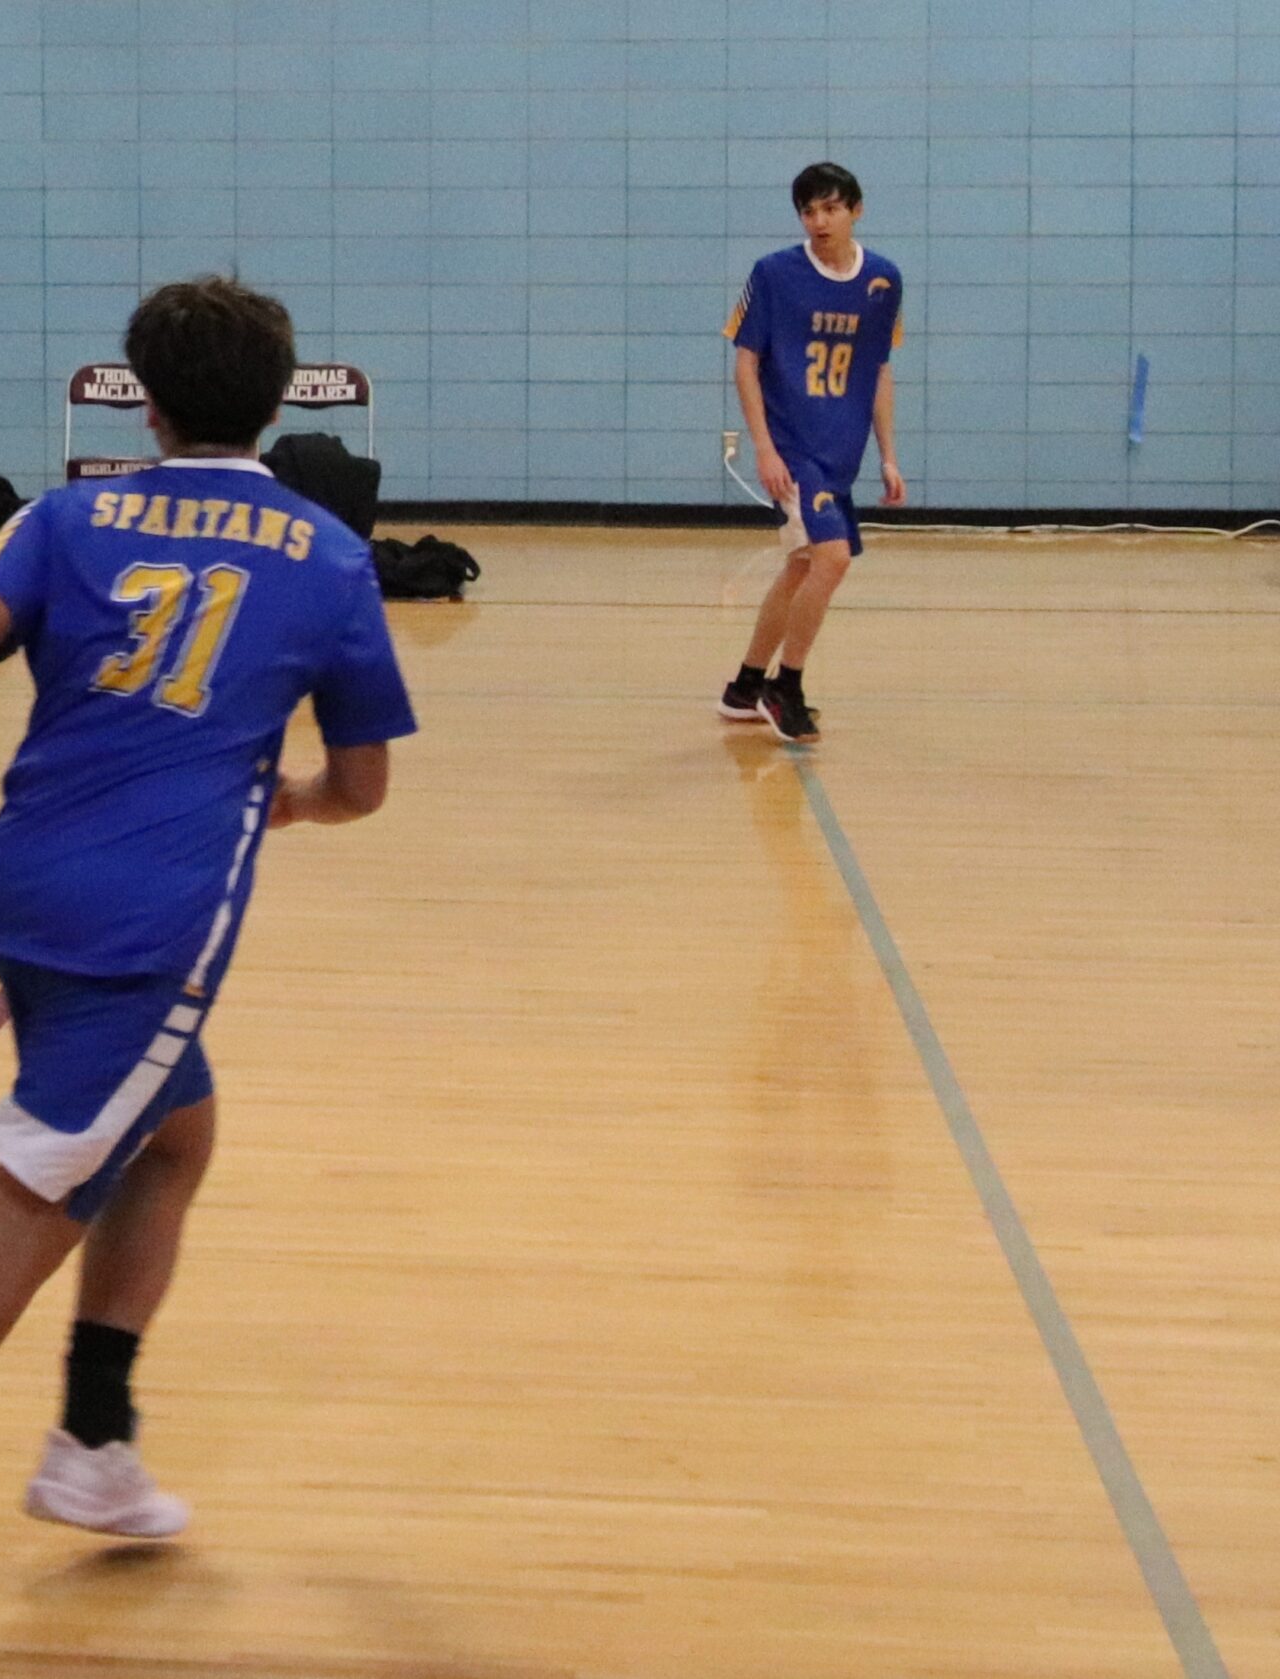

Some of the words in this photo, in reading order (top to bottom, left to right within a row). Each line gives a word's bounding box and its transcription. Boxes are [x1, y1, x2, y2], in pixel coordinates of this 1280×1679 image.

[811, 312, 860, 334] STEM
[93, 368, 139, 384] THOM
[293, 369, 348, 384] HOMAS
[805, 341, 853, 397] 28
[84, 383, 146, 401] MACLAR
[283, 384, 357, 401] ACLAREN
[90, 491, 316, 561] SPARTANS
[88, 561, 251, 718] 31
